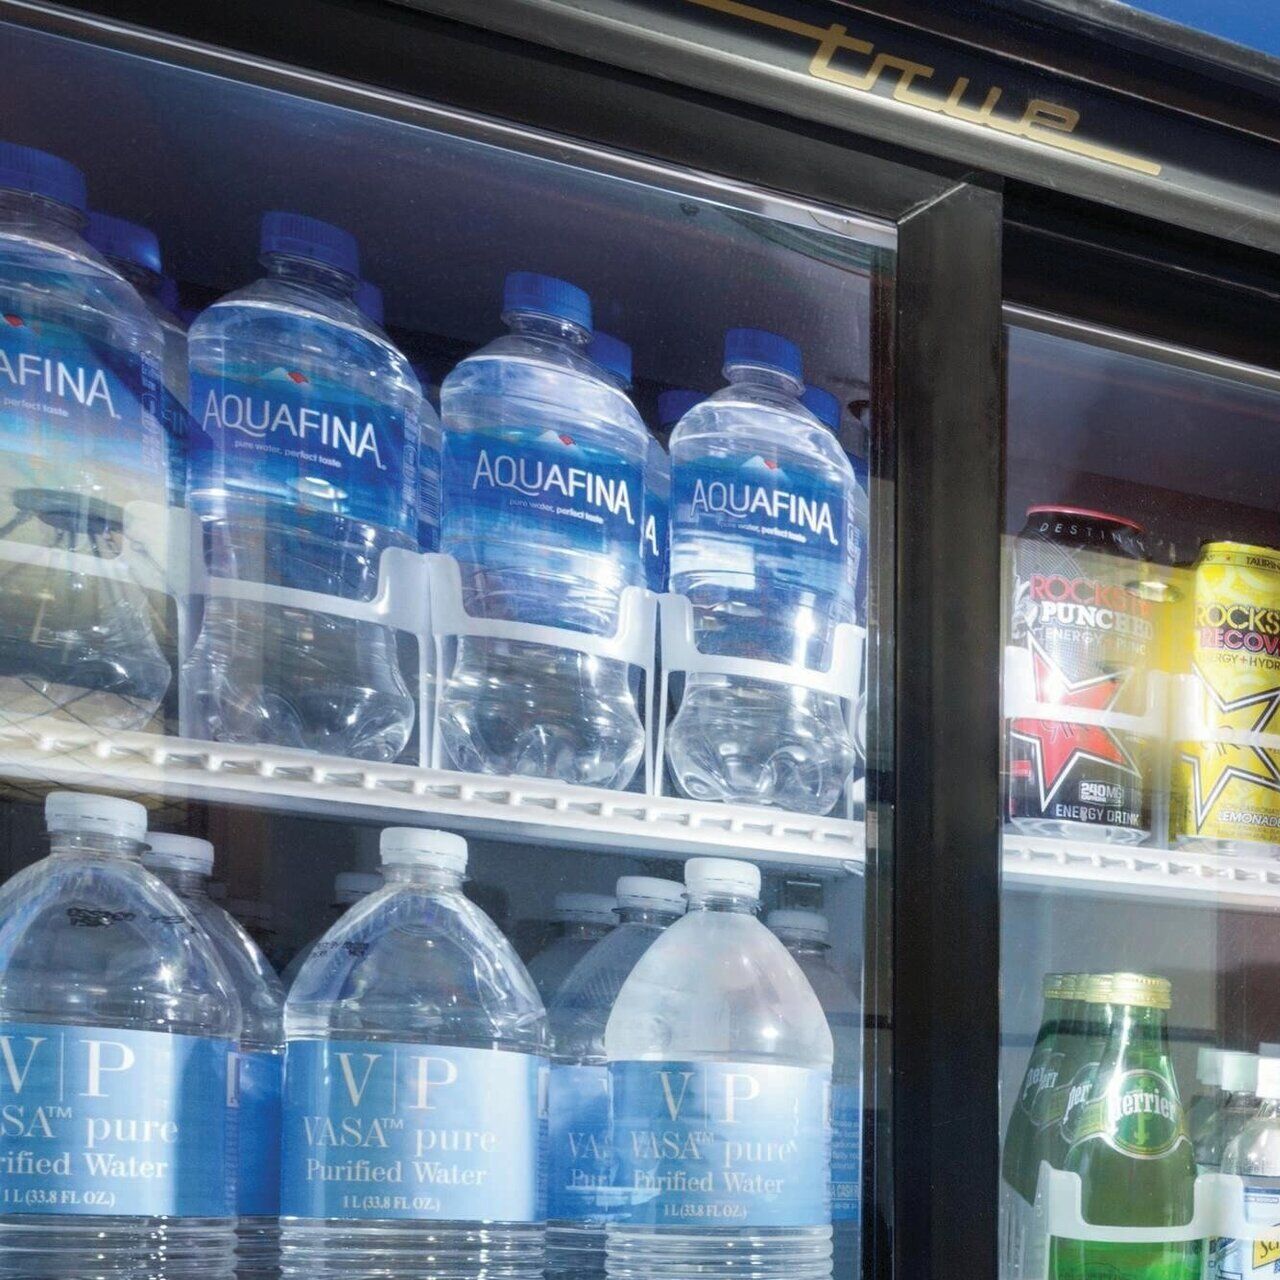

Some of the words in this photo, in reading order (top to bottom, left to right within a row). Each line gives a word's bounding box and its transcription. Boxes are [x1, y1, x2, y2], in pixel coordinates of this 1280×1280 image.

[807, 23, 1085, 140] true
[203, 389, 387, 471] AQUAFINA
[473, 450, 634, 525] AQUAFINA
[691, 479, 838, 546] AQUAFINA
[1055, 804, 1104, 822] ENERGY
[1107, 810, 1140, 828] DRINK
[306, 1159, 402, 1184] Purified
[413, 1161, 487, 1187] Water
[634, 1170, 713, 1192] Purified
[725, 1172, 785, 1195] Water
